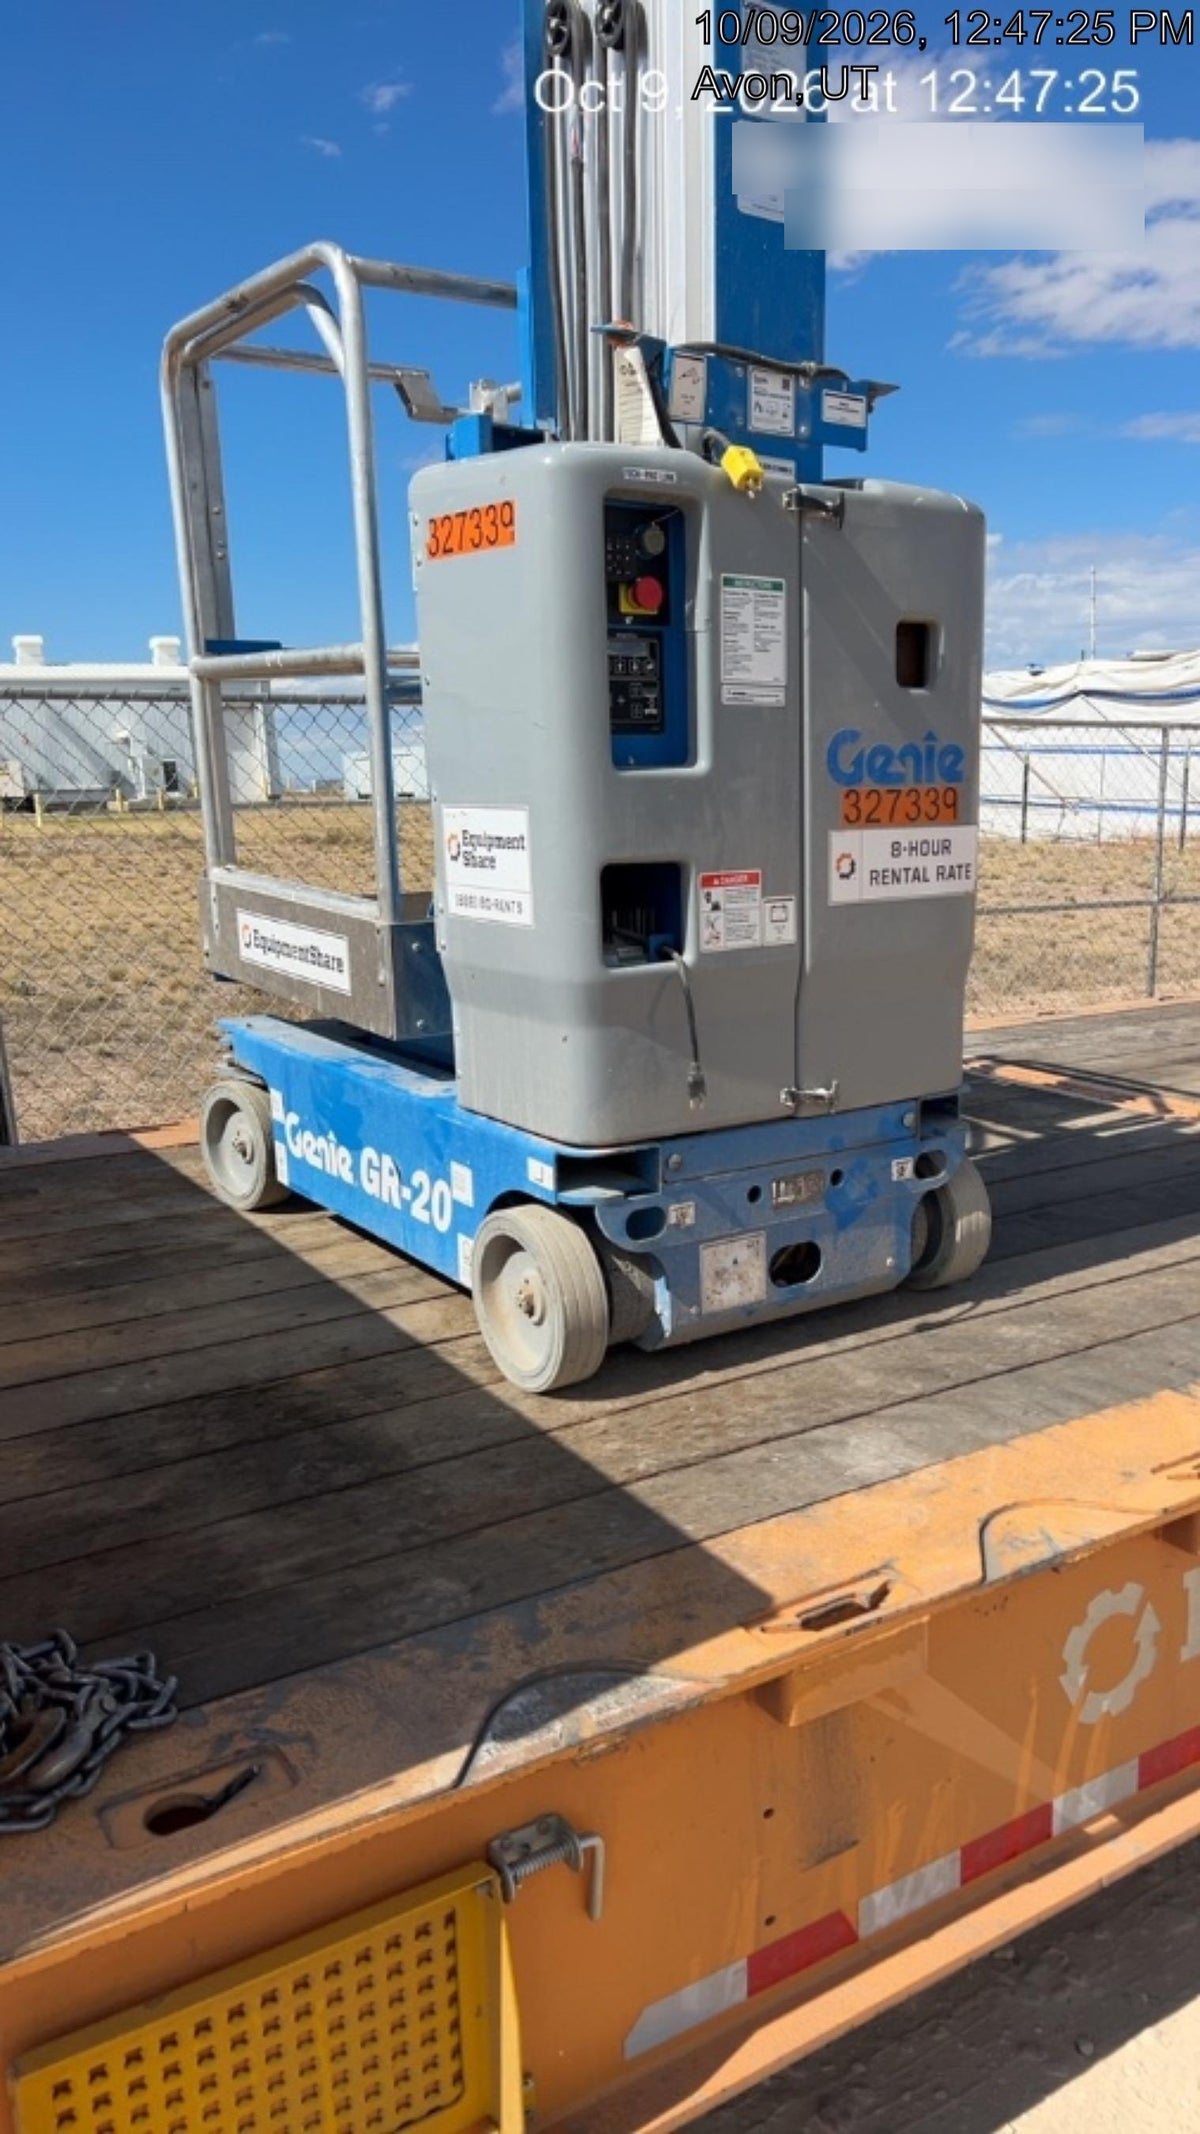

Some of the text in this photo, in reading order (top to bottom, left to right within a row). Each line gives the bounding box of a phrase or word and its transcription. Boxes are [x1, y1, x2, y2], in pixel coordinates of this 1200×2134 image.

[428, 500, 514, 557] 327339
[827, 728, 965, 787] Genie
[843, 786, 959, 825] 327339
[462, 829, 525, 852] Equipment
[462, 850, 496, 869] Share
[891, 839, 952, 859] 8-HOUR
[869, 863, 972, 887] RENTAL RATE
[253, 929, 345, 973] EquipmentShare
[284, 1111, 454, 1234] Genie GR-20
